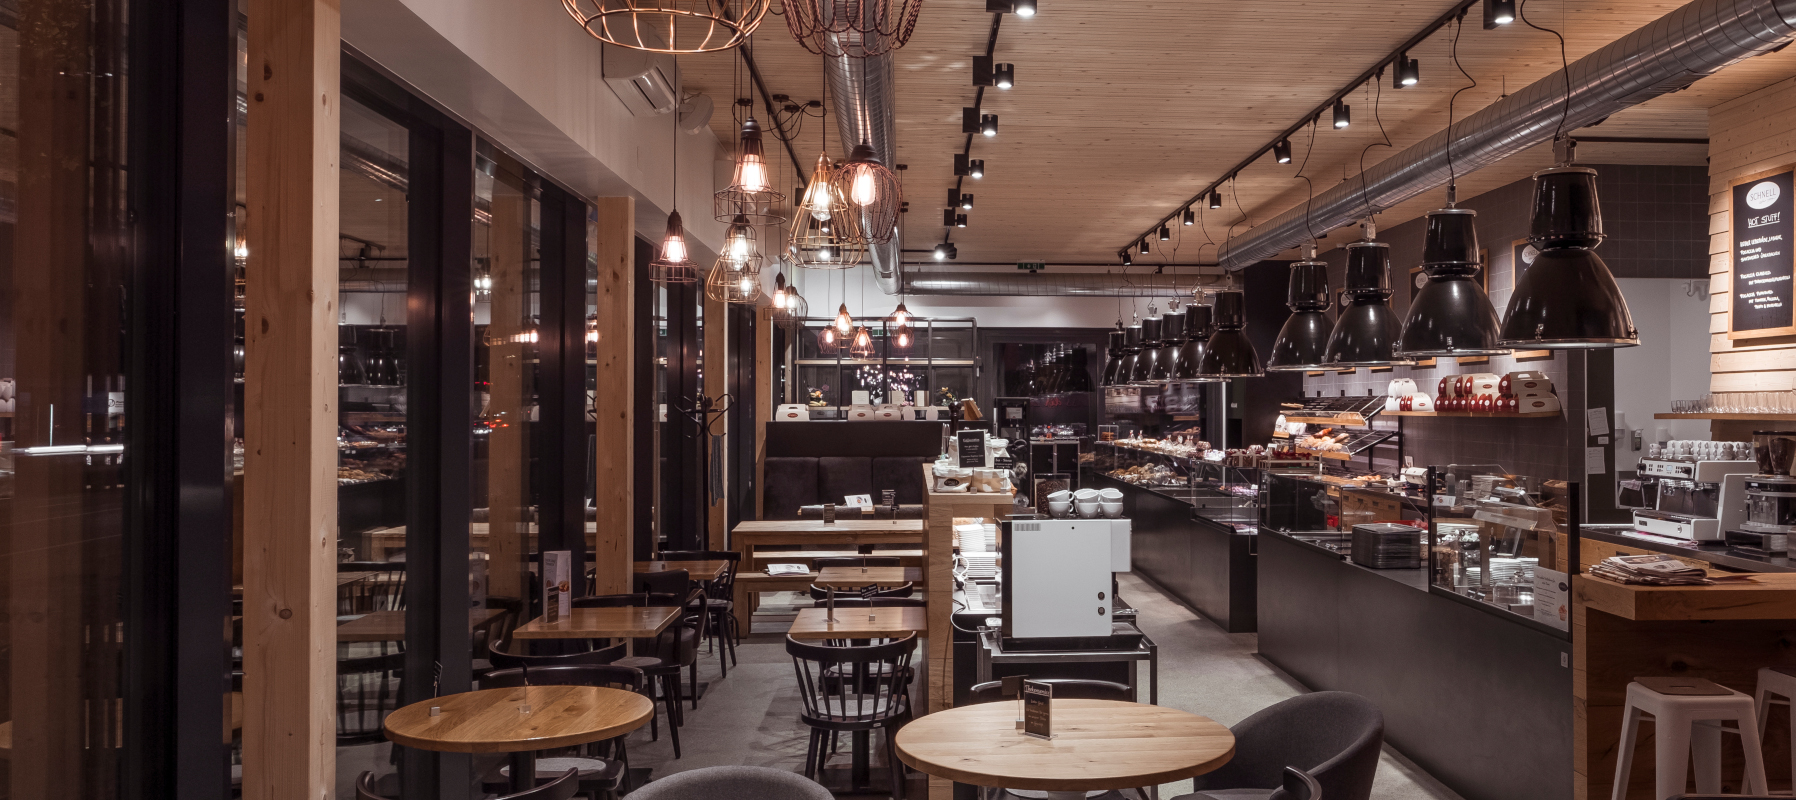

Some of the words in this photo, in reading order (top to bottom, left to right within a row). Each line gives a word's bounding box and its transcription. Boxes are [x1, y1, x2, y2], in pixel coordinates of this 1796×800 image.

[1750, 188, 1776, 201] SCHNELL
[1748, 216, 1759, 226] HOT
[1761, 211, 1780, 223] STUFF!
